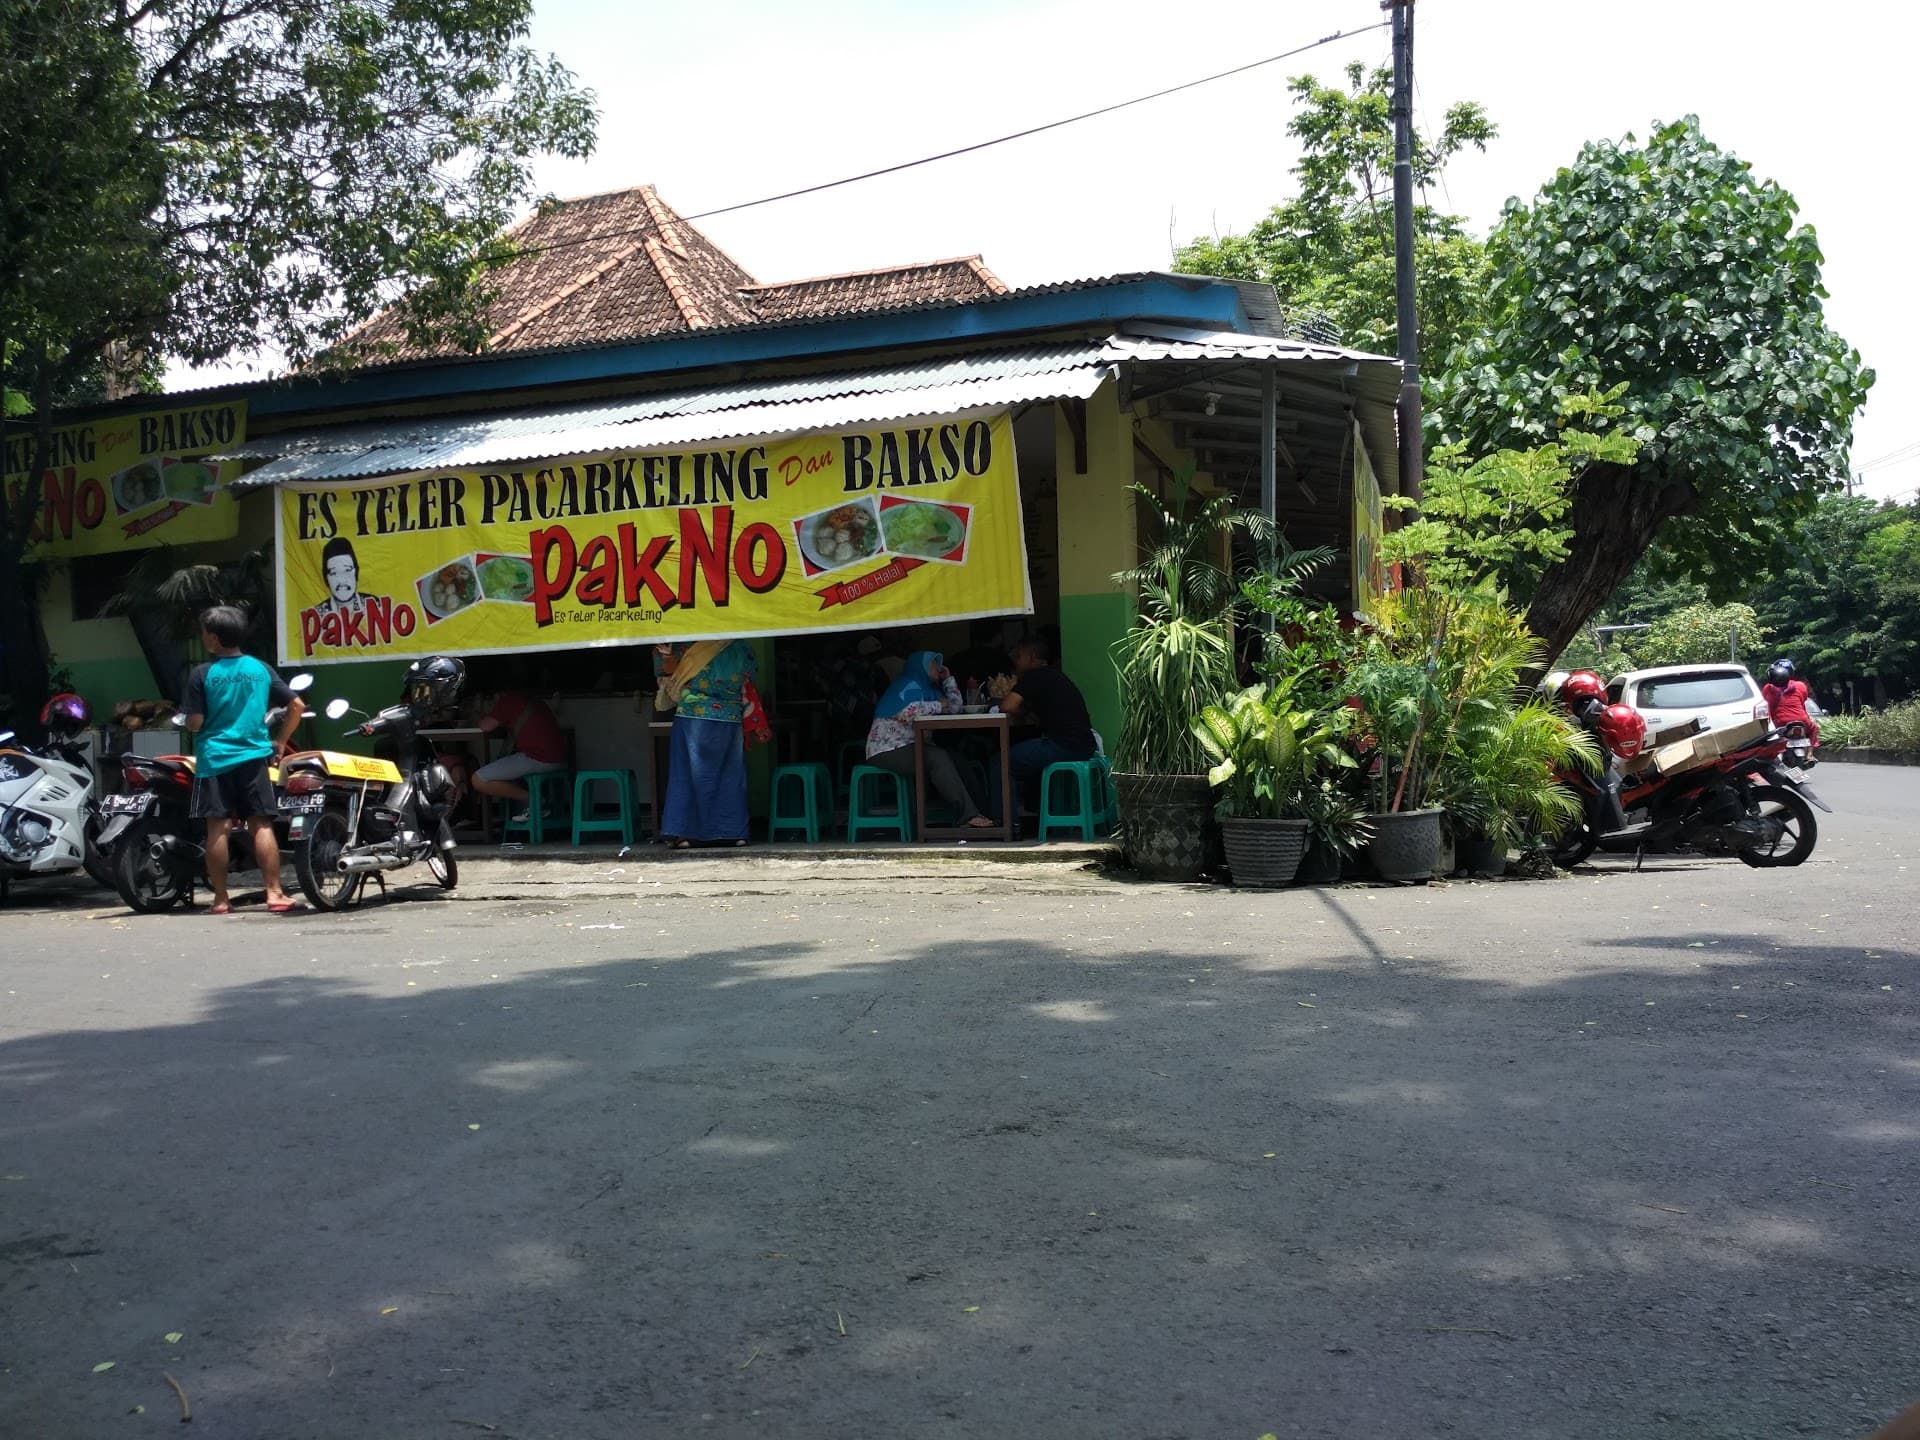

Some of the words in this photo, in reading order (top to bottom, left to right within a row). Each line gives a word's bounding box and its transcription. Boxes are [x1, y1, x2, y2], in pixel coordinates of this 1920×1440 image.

[103, 428, 134, 452] Dan
[140, 406, 236, 455] BAKSO
[298, 491, 337, 540] ES
[353, 477, 466, 536] TELER
[480, 446, 769, 523] PACARKELING
[778, 450, 833, 486] Dan
[841, 420, 992, 491] BAKSO
[843, 579, 862, 600] 100
[874, 565, 902, 587] Halal
